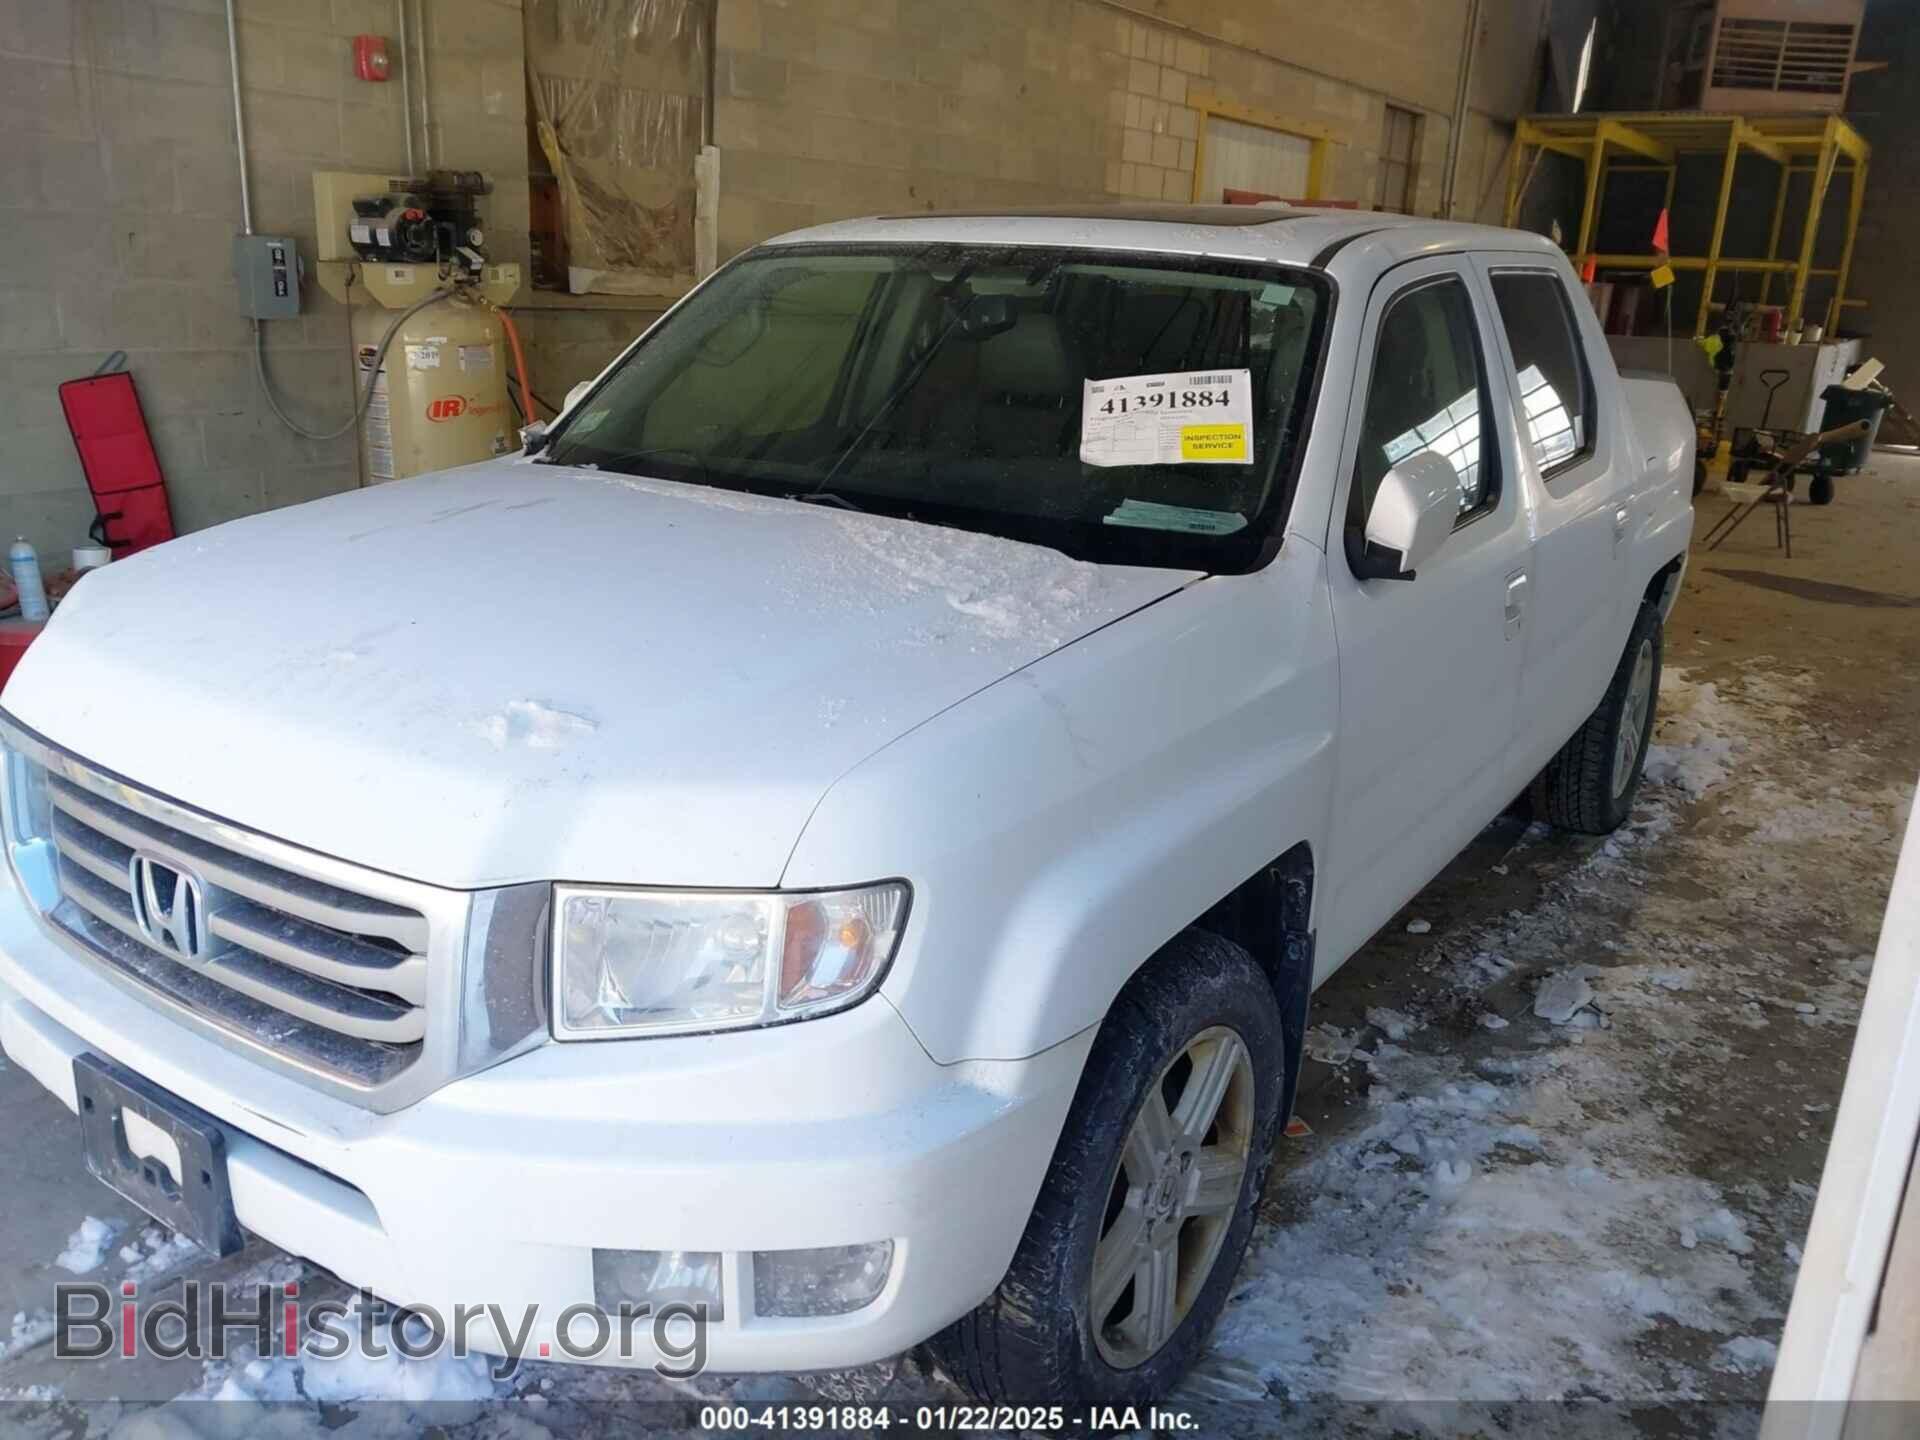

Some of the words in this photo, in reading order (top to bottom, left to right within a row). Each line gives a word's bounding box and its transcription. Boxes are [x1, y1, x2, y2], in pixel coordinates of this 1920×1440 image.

[432, 400, 461, 417] IR
[1100, 390, 1230, 414] 41391884
[1183, 433, 1241, 441] INSPECTION
